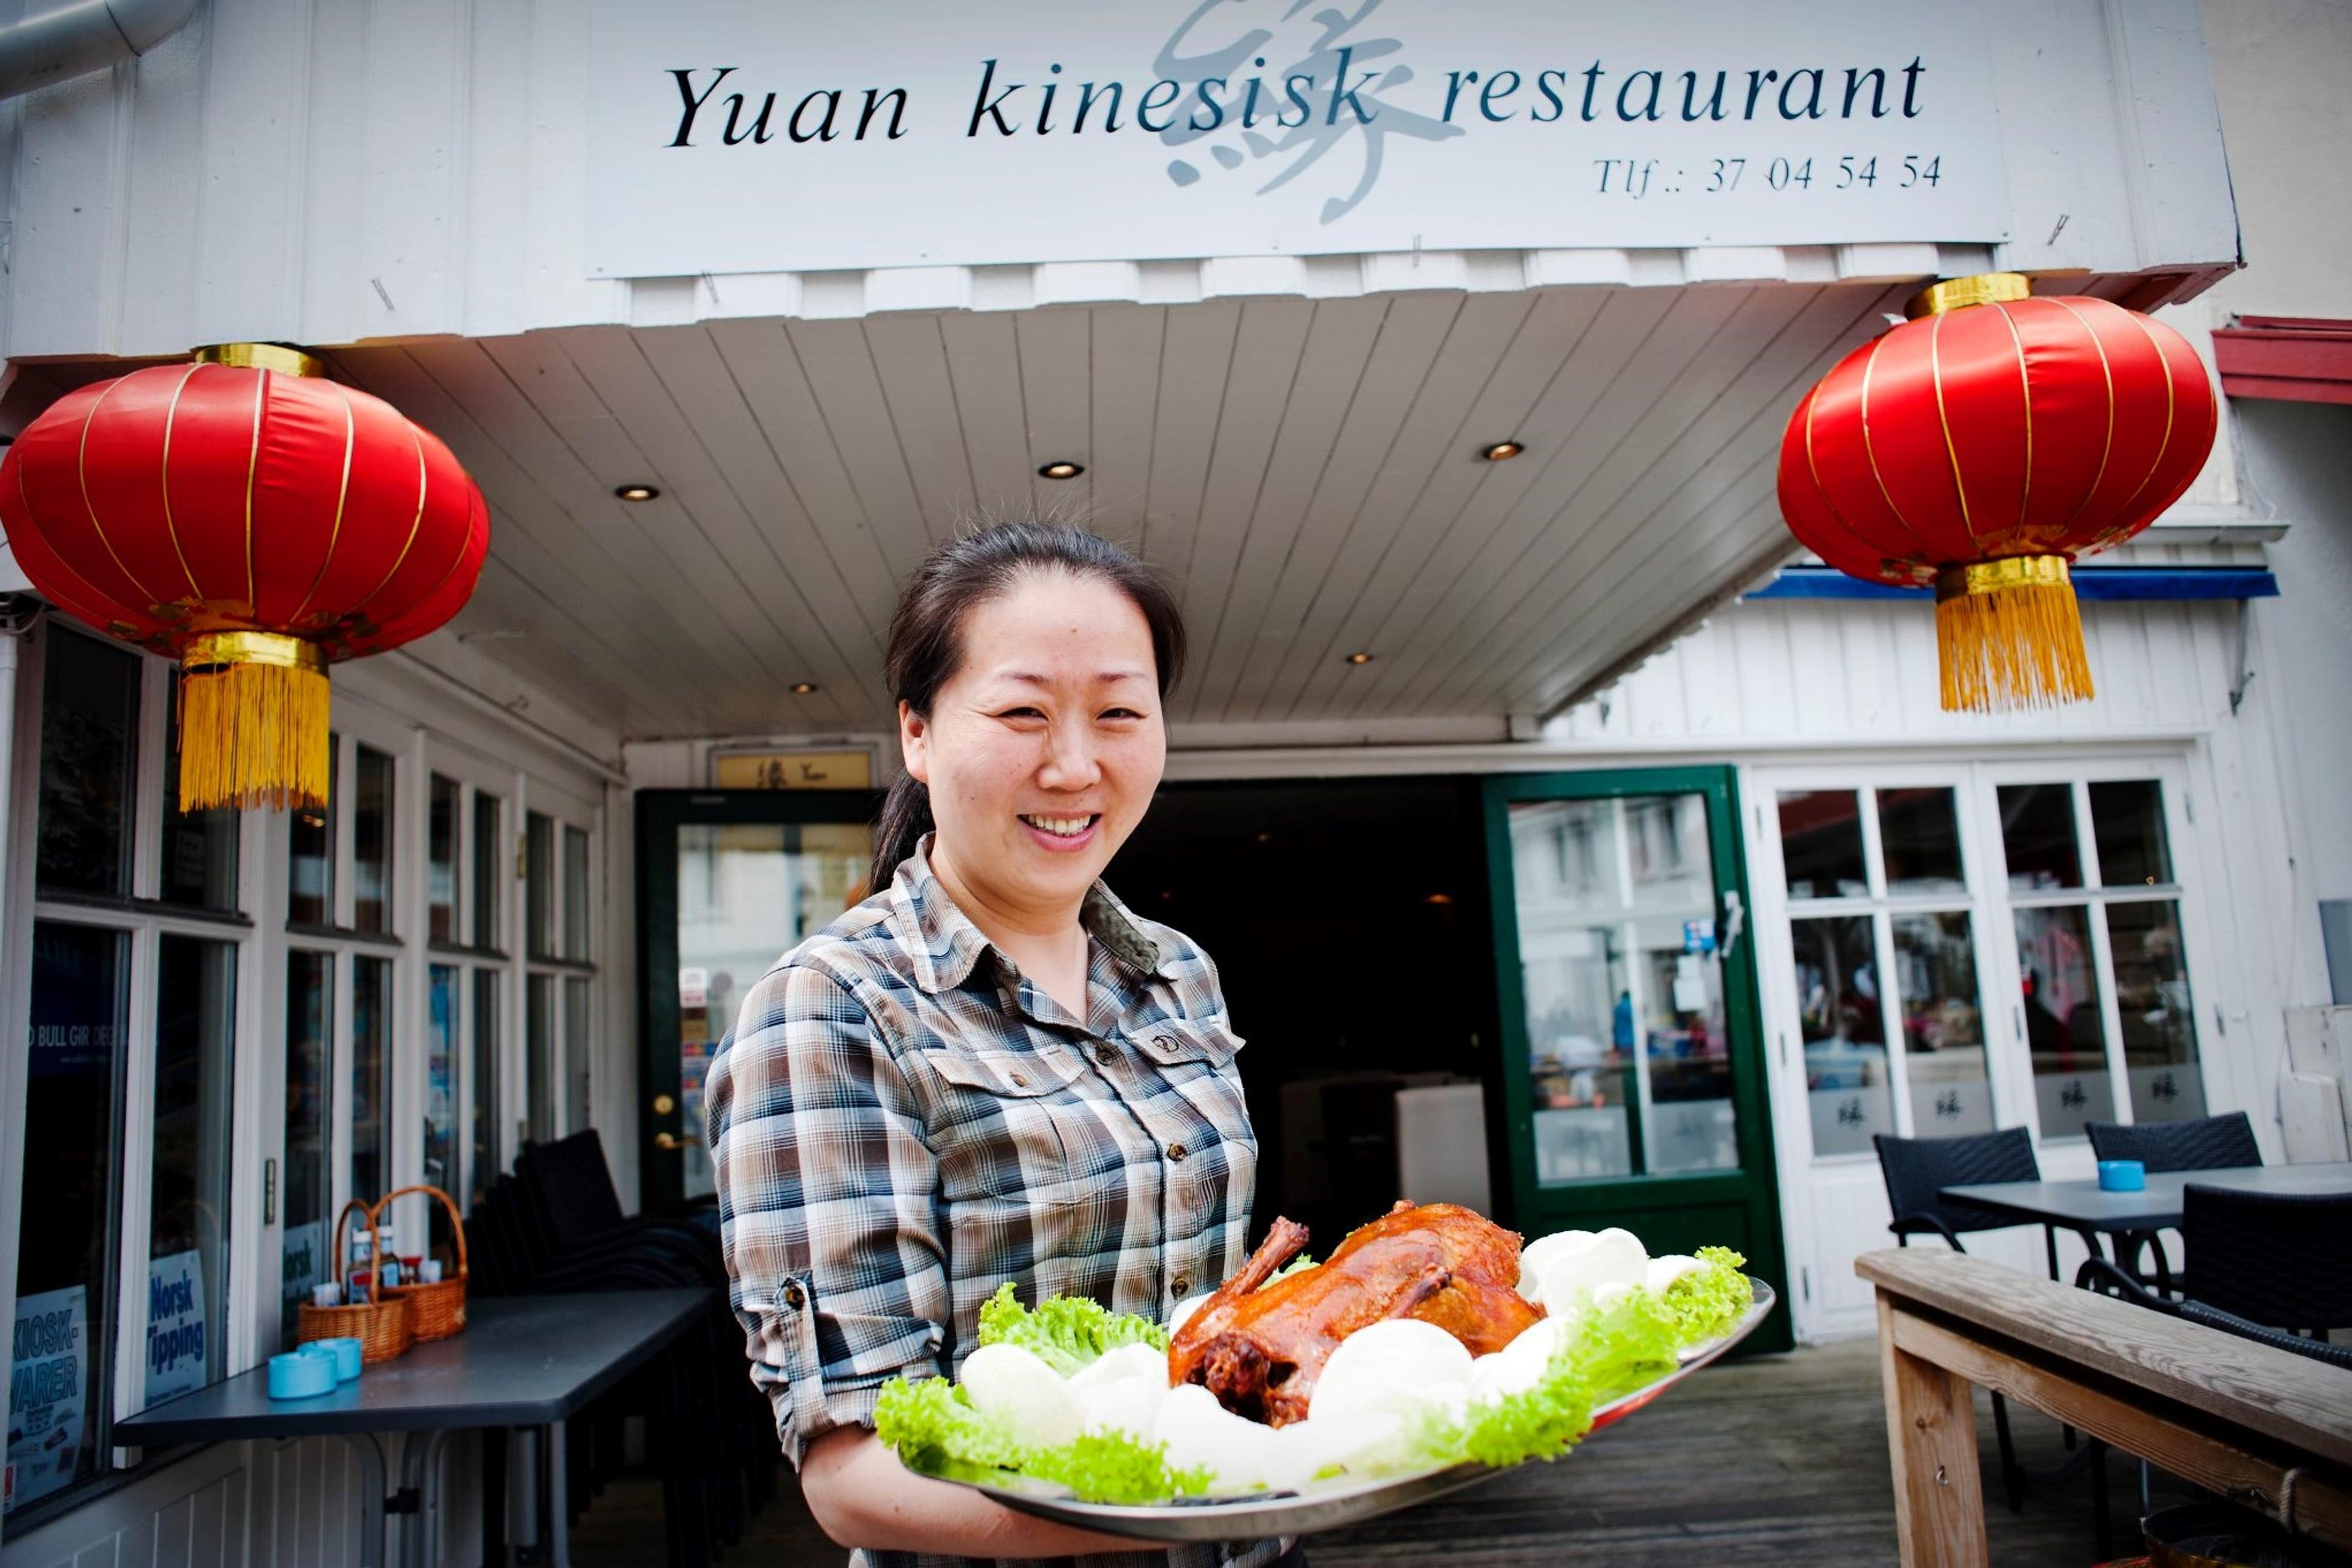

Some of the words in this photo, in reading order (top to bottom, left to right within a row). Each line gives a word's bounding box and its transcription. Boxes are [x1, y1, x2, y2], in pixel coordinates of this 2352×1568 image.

[662, 67, 909, 148] Yuan
[967, 47, 1382, 137] kinesisk
[1441, 56, 1926, 122] restaurant
[1706, 159, 1746, 192] 37
[1768, 157, 1812, 191] 04
[1836, 156, 1879, 189] 54
[1901, 155, 1941, 188] 54
[38, 1025, 66, 1047] BULL
[69, 1025, 90, 1047] GIR
[151, 1270, 194, 1323] Norsk
